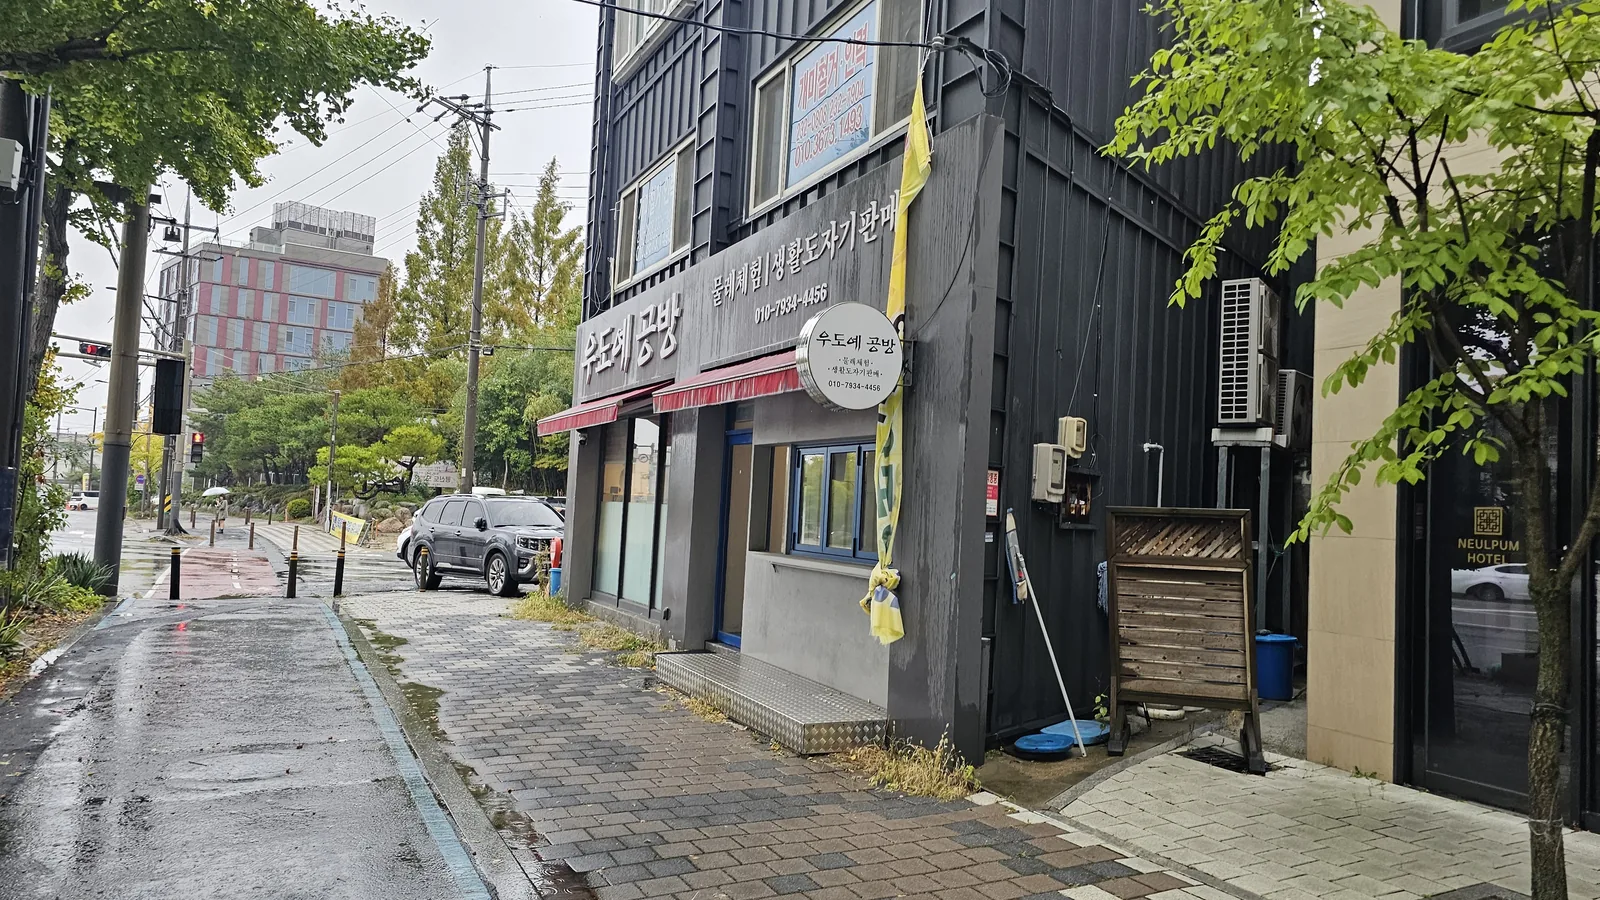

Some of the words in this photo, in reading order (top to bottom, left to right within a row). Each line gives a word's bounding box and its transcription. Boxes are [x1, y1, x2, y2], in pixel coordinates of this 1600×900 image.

[798, 46, 839, 110] 개미철거
[771, 189, 900, 282] 생활도자기판매
[754, 283, 829, 324] 010-7934-4456
[581, 313, 635, 385] 우도예
[636, 292, 683, 367] 공방
[816, 330, 861, 352] 우도예
[866, 336, 896, 354] 공방
[828, 380, 881, 392] 010-7934-4456
[1457, 538, 1520, 551] NEULPUM
[1467, 553, 1508, 565] HOTEL
